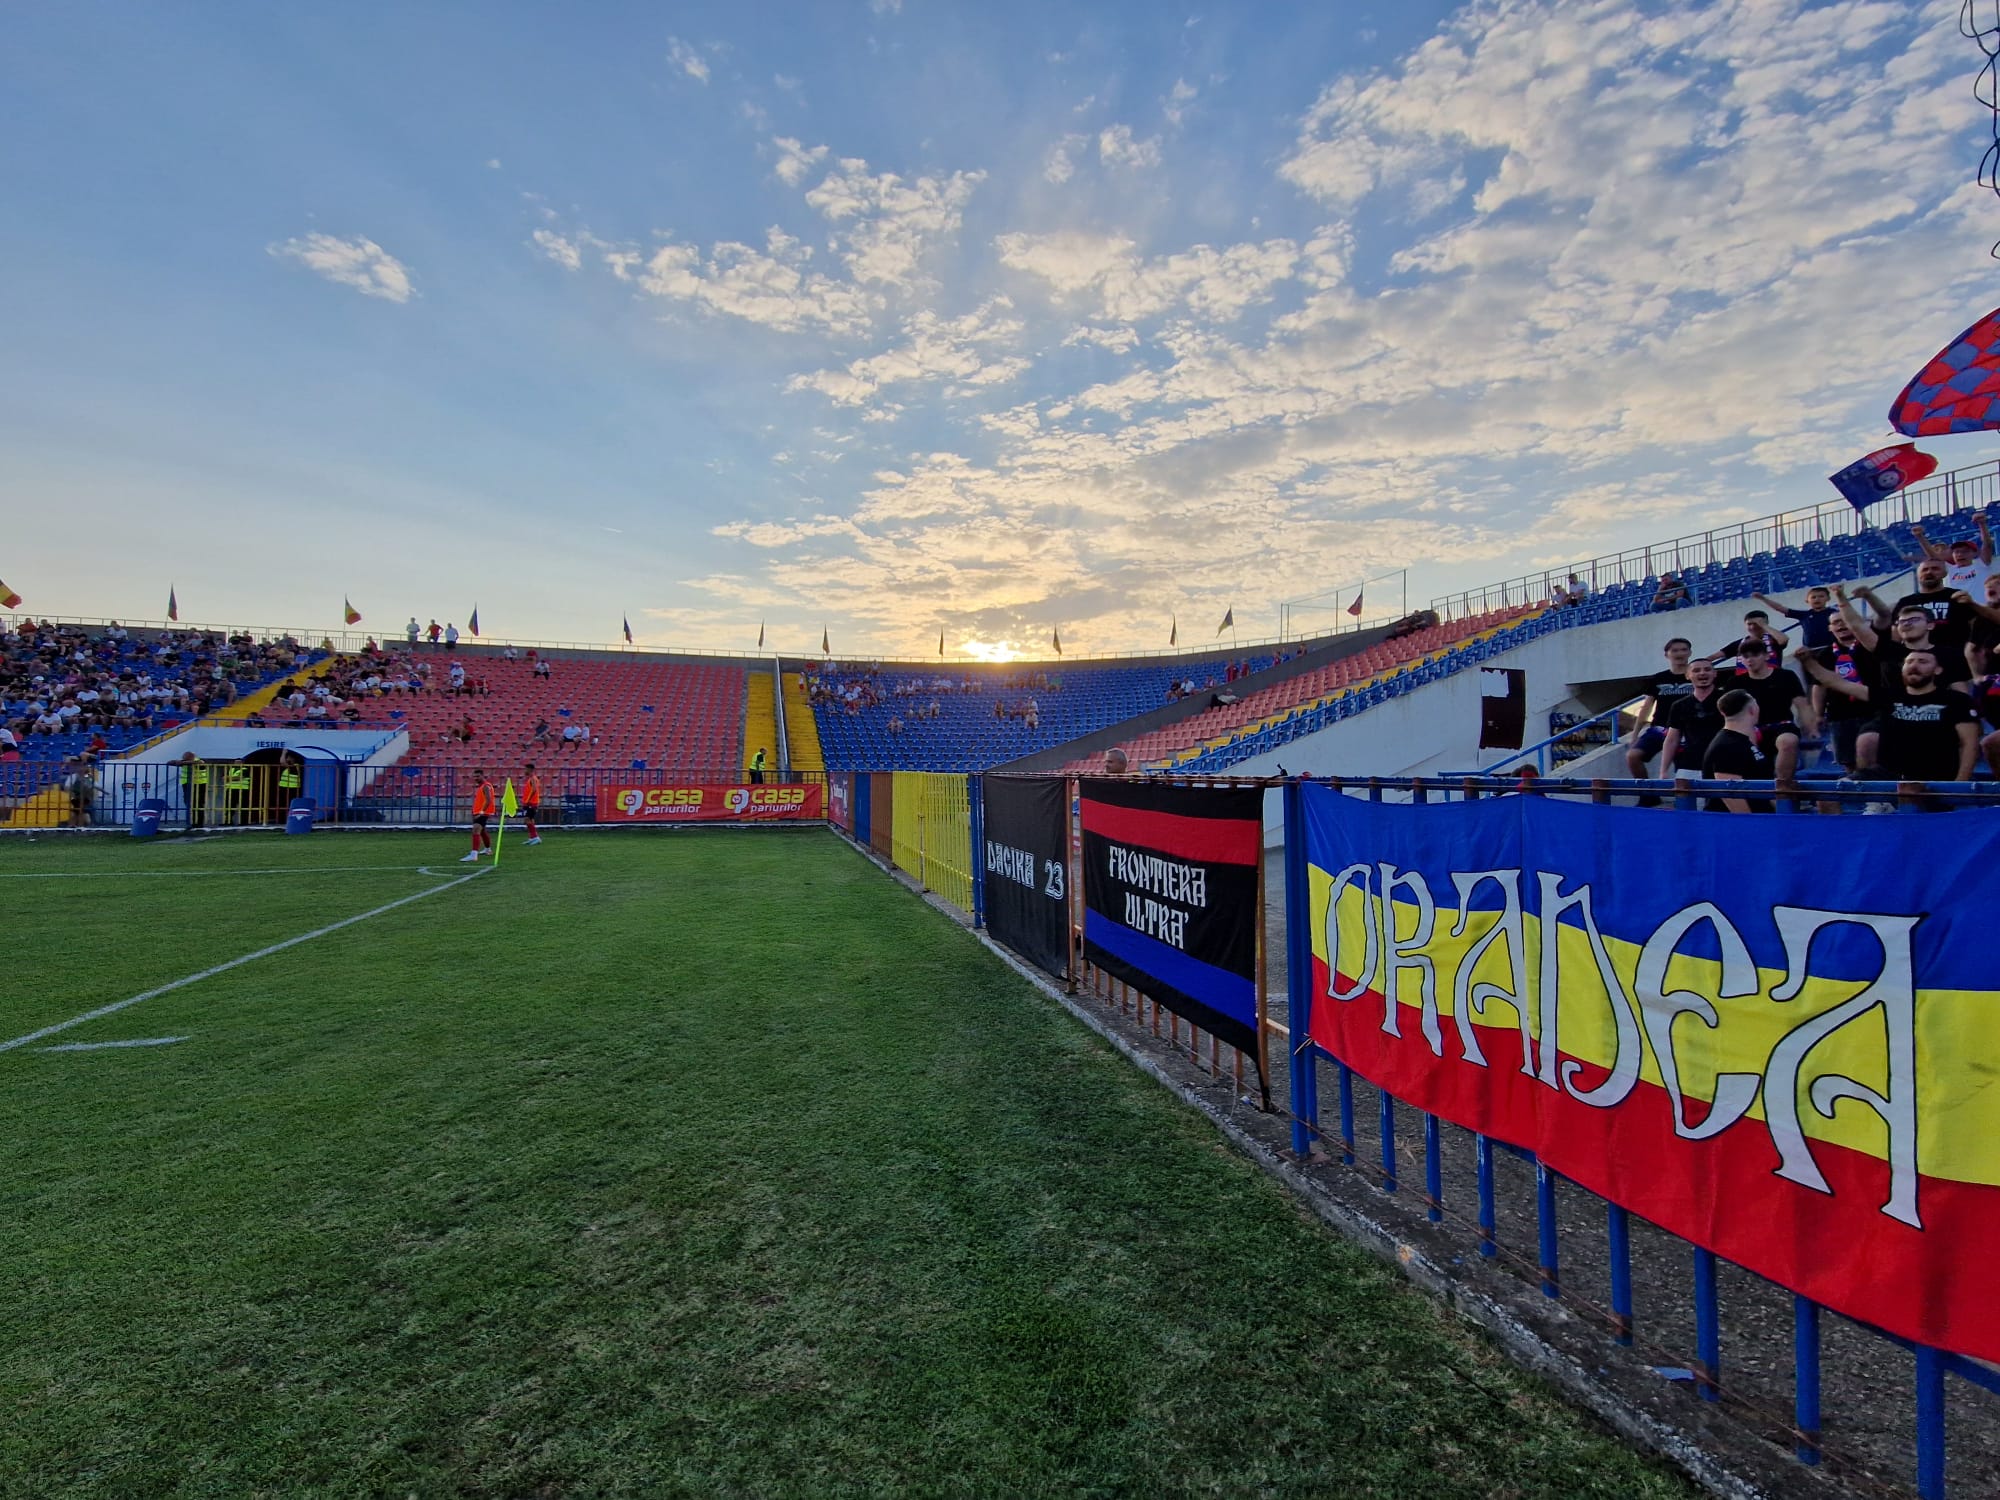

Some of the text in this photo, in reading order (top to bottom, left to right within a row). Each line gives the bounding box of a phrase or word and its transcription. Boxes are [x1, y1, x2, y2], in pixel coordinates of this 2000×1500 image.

[646, 789, 704, 805] casa
[752, 788, 805, 804] casa
[644, 804, 701, 815] pariurilor
[750, 803, 803, 814] pariurilor
[1044, 859, 1064, 900] 23
[1109, 845, 1206, 908] FRONTIERA
[1325, 862, 1929, 1230] ORADEA
